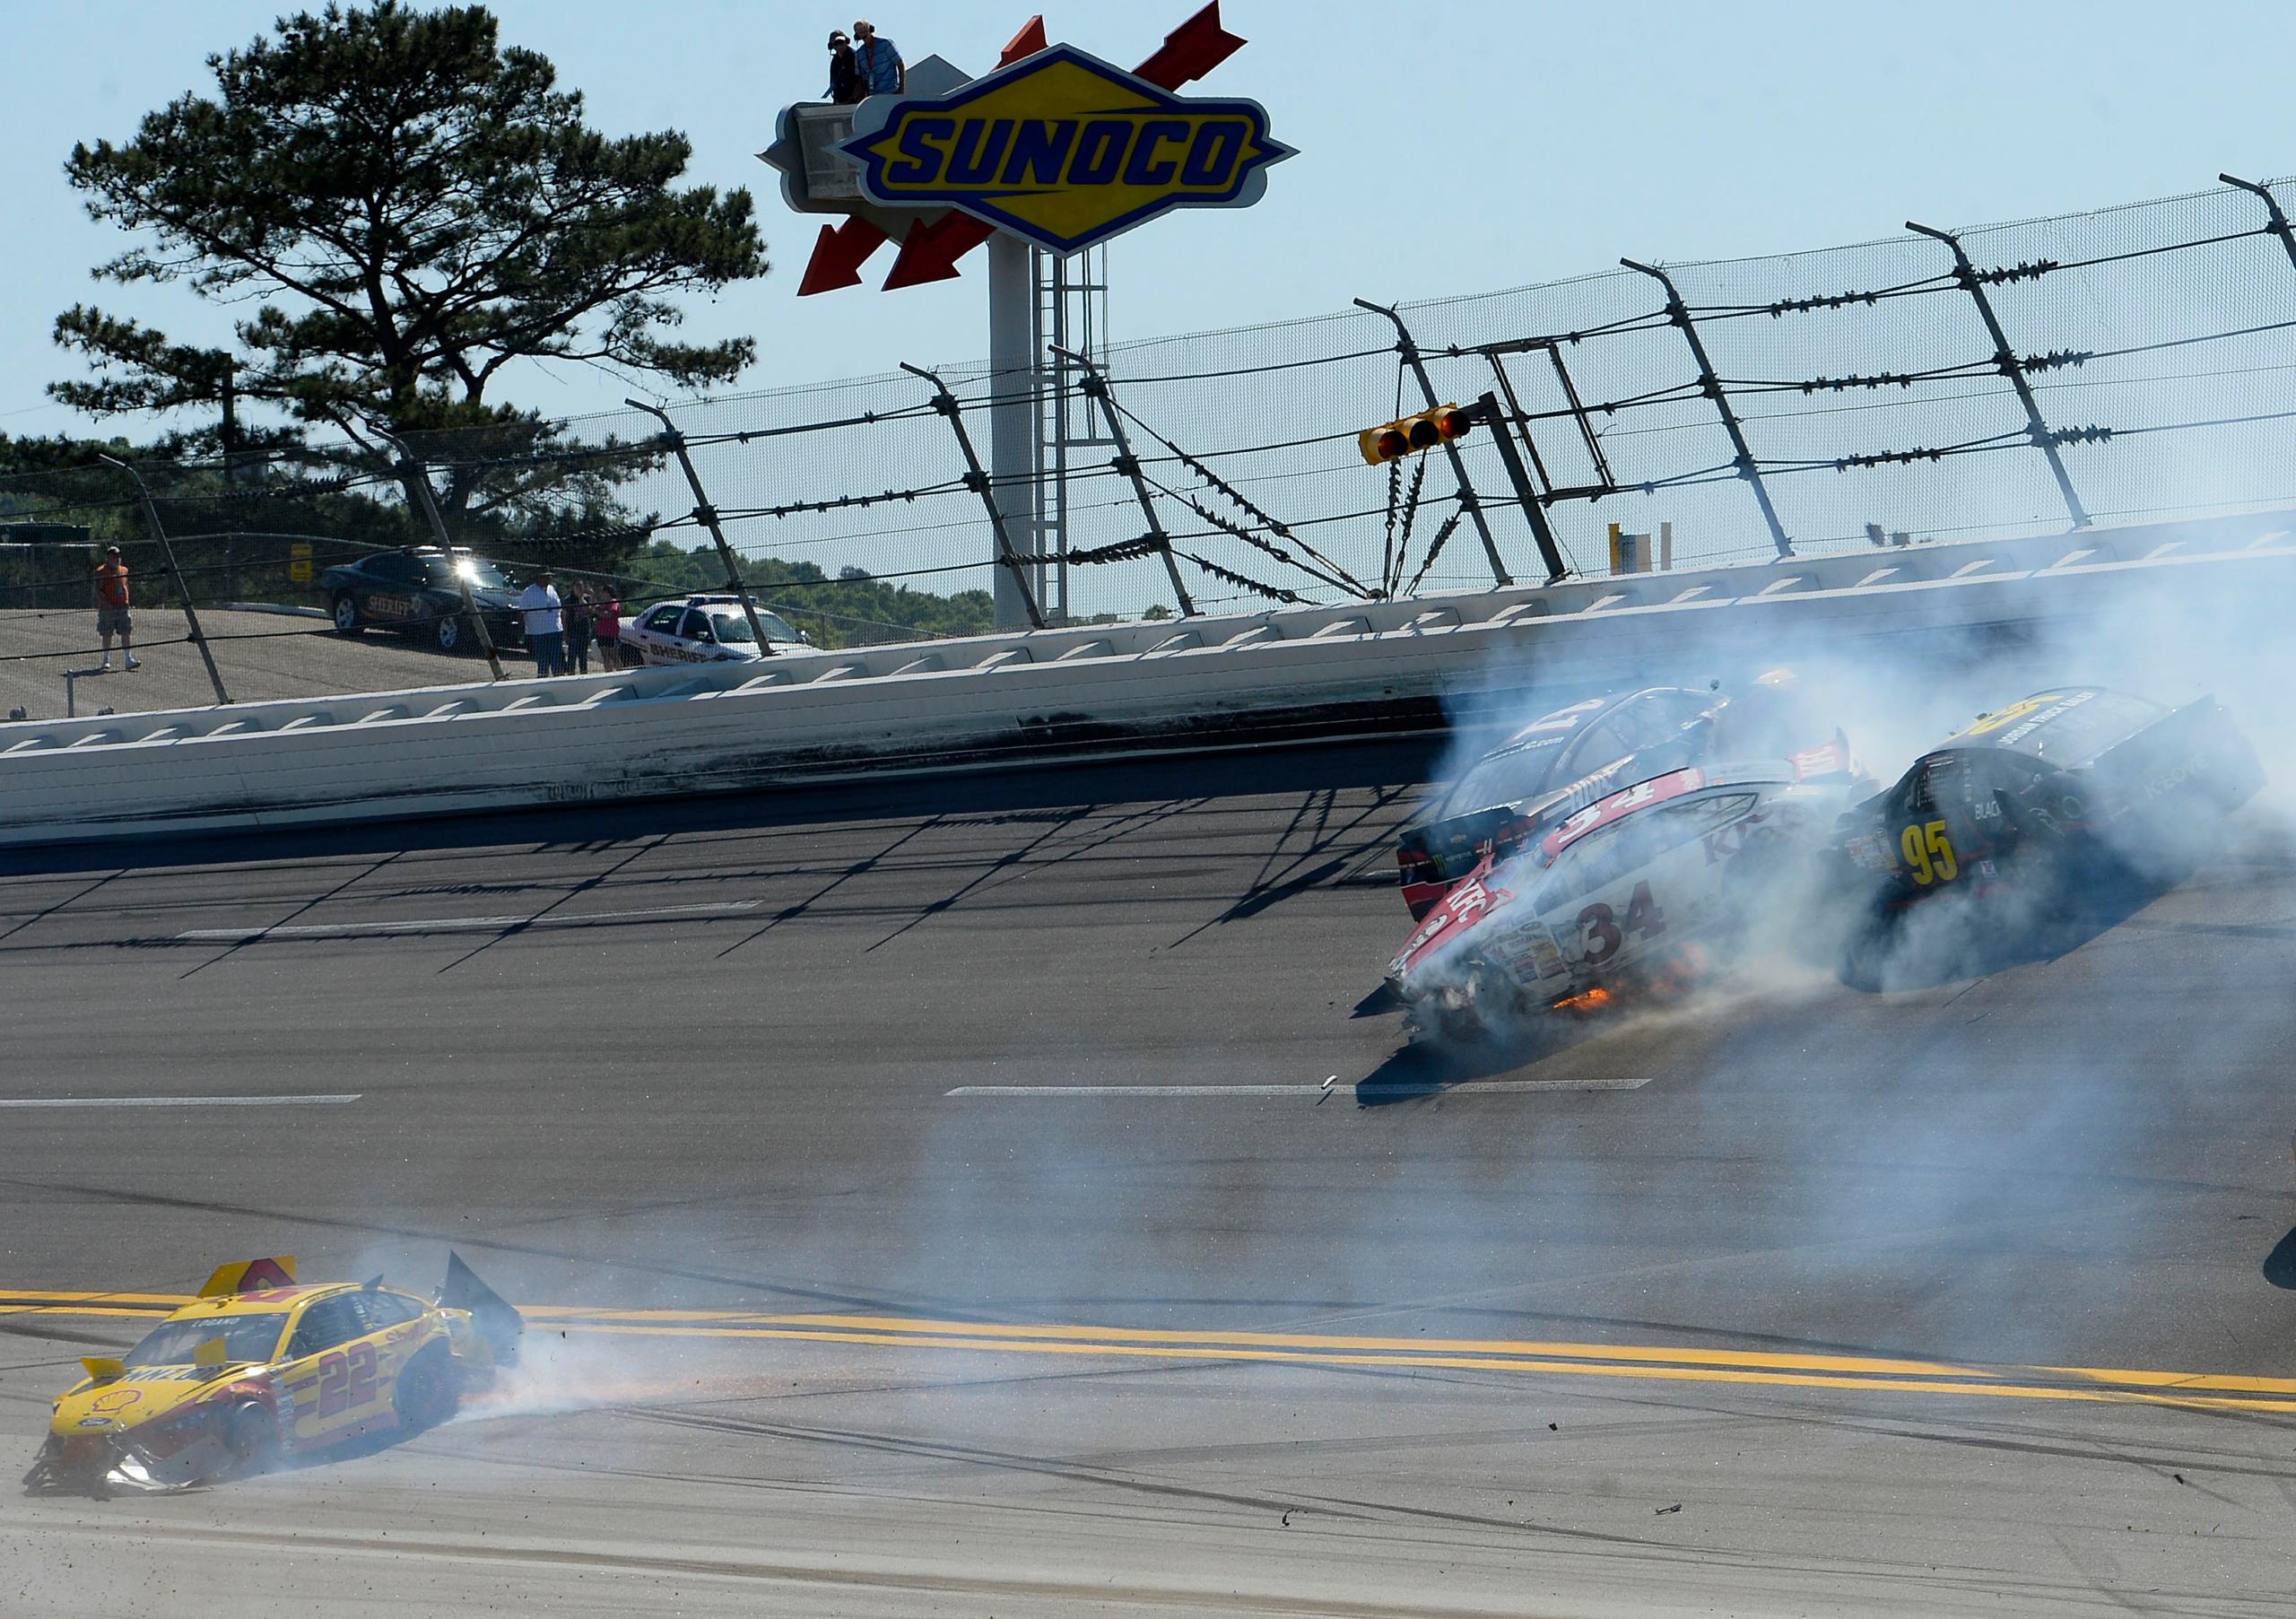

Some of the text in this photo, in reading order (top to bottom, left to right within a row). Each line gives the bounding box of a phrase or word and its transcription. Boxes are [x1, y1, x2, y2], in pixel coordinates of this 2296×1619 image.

[887, 118, 1248, 186] SUNOCO
[369, 595, 412, 615] SHERIFF
[1901, 820, 1958, 884] 95
[1447, 877, 1487, 923] KFC
[1576, 879, 1667, 965] 34
[190, 1317, 240, 1327] LOGANO
[318, 1342, 377, 1420] 22
